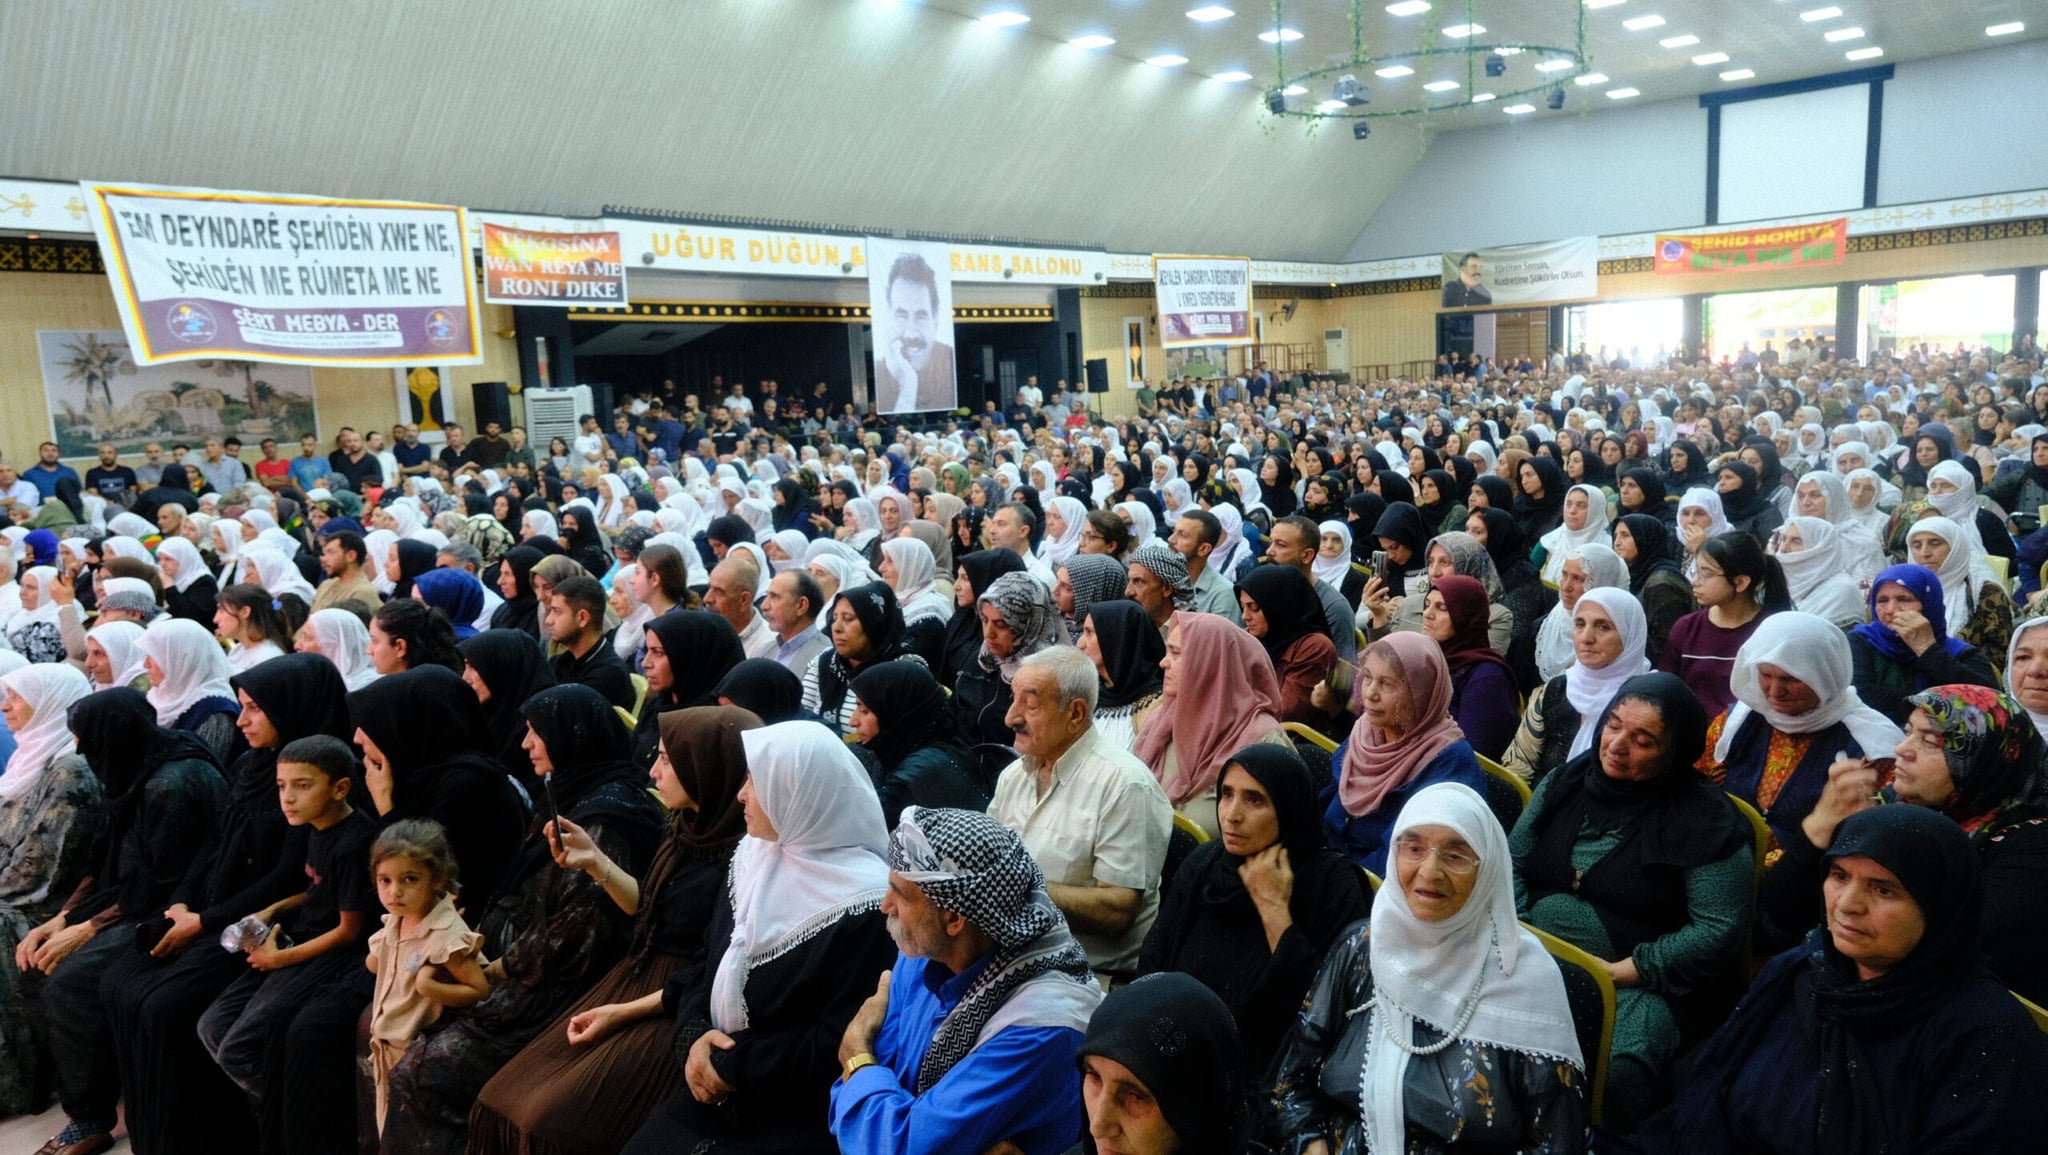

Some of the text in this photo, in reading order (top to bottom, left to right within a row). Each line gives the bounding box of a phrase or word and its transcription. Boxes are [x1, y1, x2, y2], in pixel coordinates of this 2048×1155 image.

[120, 211, 455, 258] EM DEYNDARÊ ŞEHÎDÊN XWE NE,
[652, 228, 736, 260] UĞUR
[748, 235, 840, 266] DÜĞÜN
[850, 245, 865, 267] &
[1011, 255, 1083, 276] SALONU
[1757, 246, 1793, 264] ME
[1801, 242, 1836, 261] NE
[166, 256, 441, 296] ŞEHÎDÊN ME RÛMETA ME NE
[487, 254, 534, 273] WAN
[594, 262, 622, 277] ME
[501, 277, 618, 298] RONI DIKE
[232, 307, 276, 331] SÊRT
[284, 314, 350, 333] MEBYA
[363, 313, 399, 332] DER
